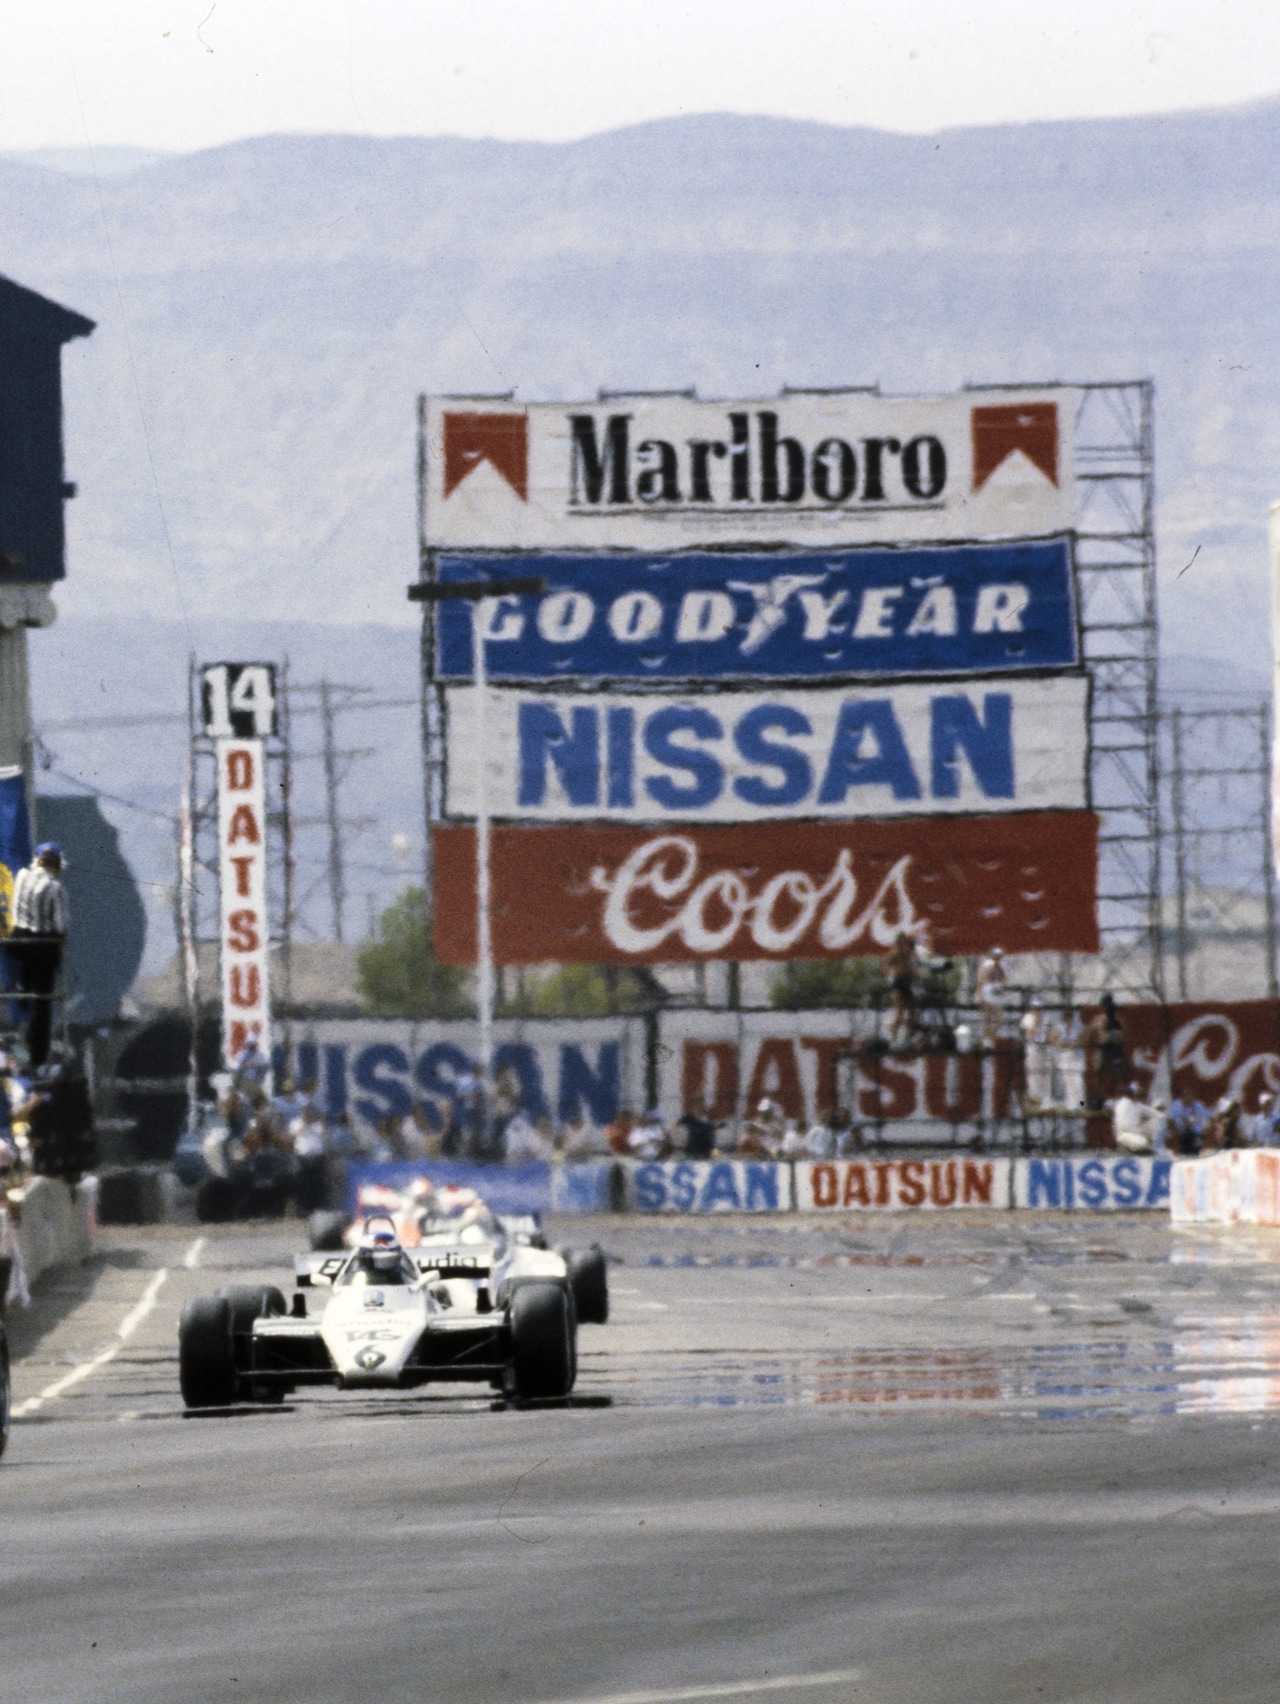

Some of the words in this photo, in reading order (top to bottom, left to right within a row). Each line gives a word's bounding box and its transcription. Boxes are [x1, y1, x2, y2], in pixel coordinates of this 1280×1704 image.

[567, 412, 948, 504] Marlboro
[204, 665, 275, 737] 14
[517, 693, 1018, 810] NISSAN
[589, 836, 931, 953] Coors
[811, 1162, 994, 1208] DATSUN
[354, 1344, 387, 1369] 6
